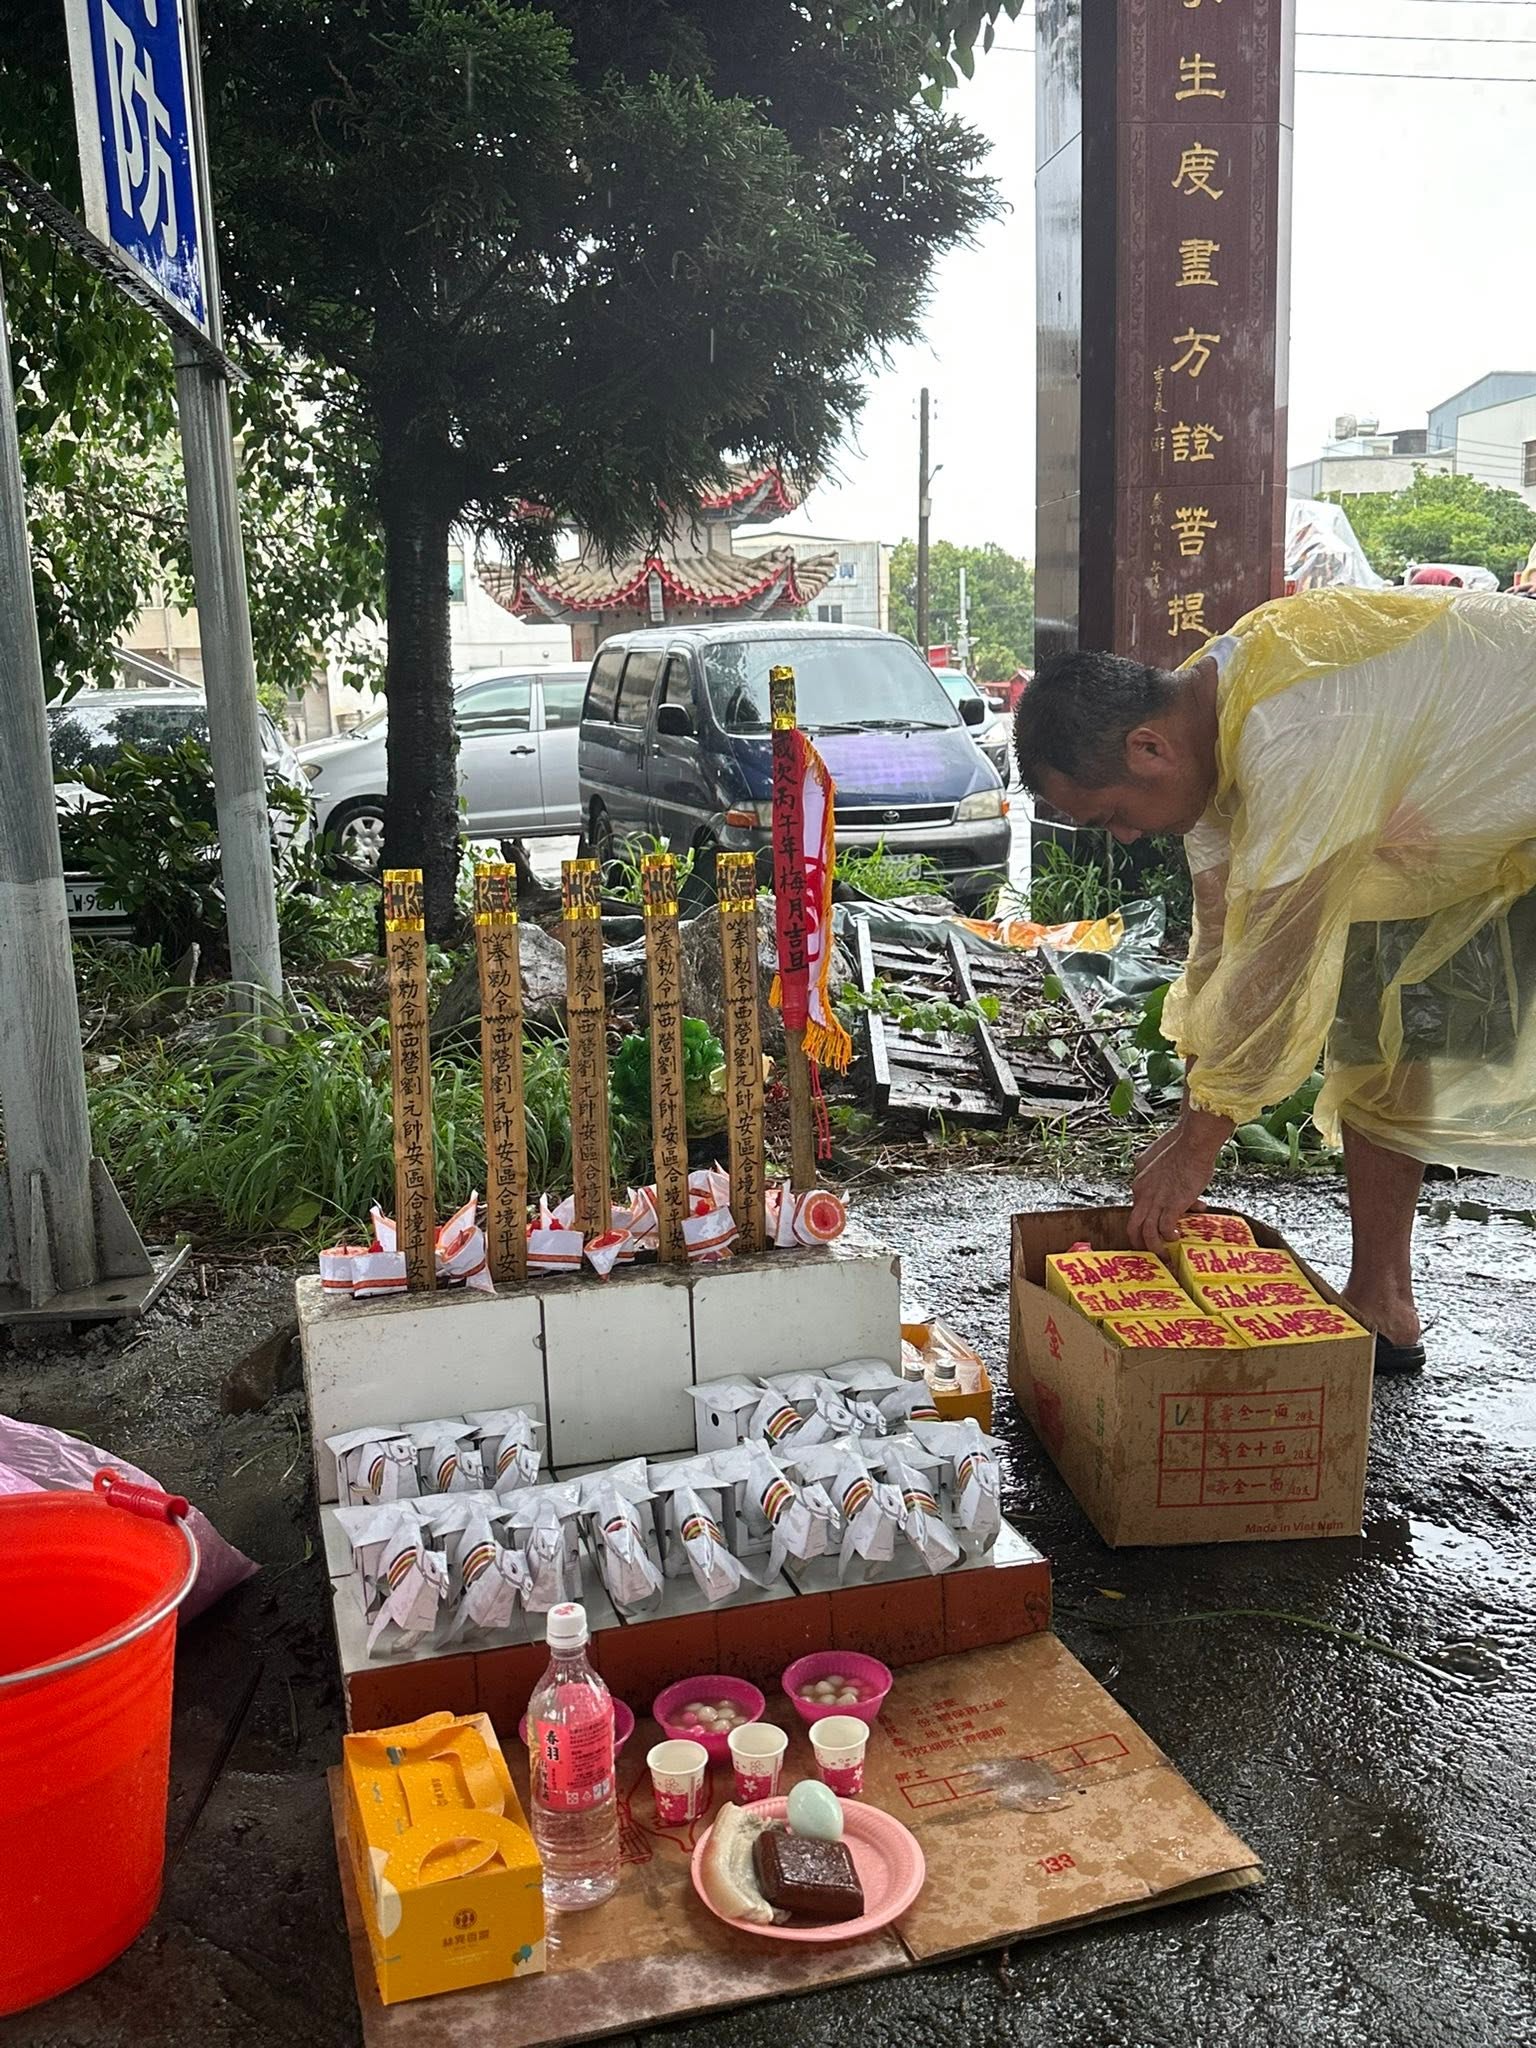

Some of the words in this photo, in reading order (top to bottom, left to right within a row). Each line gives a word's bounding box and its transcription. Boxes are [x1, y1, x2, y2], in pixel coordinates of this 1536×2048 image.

[101, 0, 178, 259] 防
[1167, 0, 1227, 637] 生度盡方證菩提
[1245, 1523, 1277, 1533] Made
[1280, 1523, 1291, 1532] in
[1293, 1521, 1314, 1532] Viet
[1318, 1520, 1344, 1531] Nam
[1038, 1852, 1077, 1875] 133
